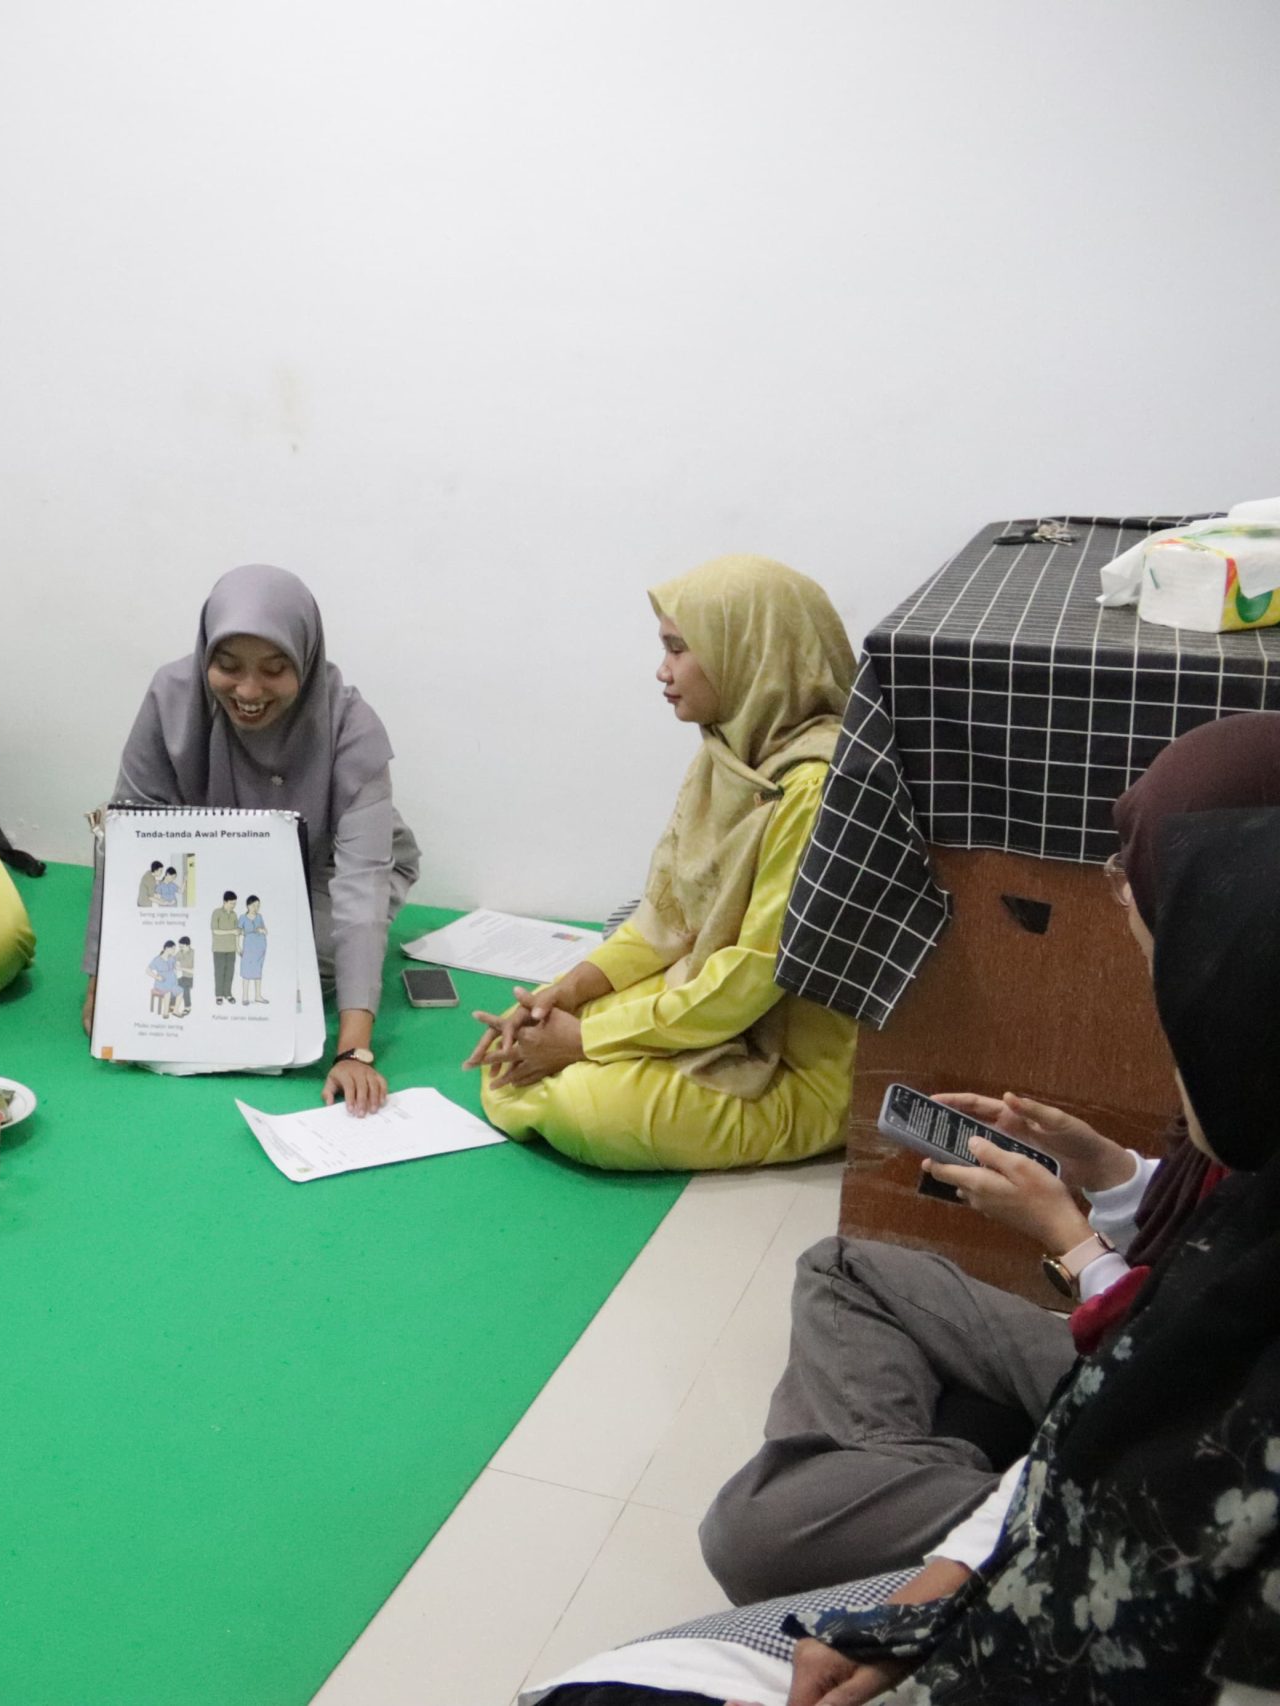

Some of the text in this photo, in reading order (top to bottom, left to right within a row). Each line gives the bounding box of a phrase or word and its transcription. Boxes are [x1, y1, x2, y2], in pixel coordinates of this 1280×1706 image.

[135, 830, 271, 838] Tanda-tanda Awal Persalinan
